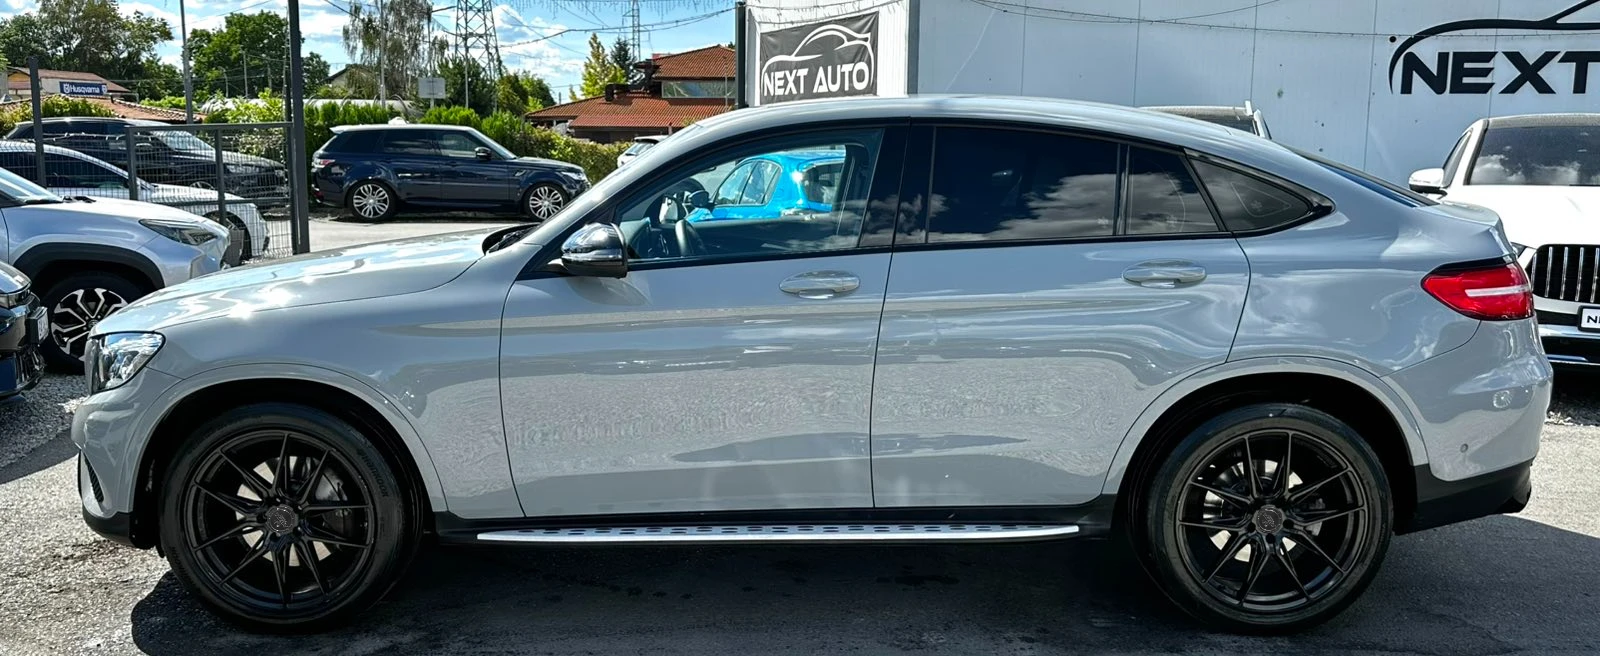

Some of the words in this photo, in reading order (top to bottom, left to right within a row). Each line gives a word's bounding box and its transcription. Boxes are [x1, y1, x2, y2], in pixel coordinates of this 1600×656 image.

[70, 84, 100, 94] Husqvarna
[763, 68, 809, 96] NEXT
[813, 61, 870, 93] AUTO
[1400, 51, 1600, 94] NEXT
